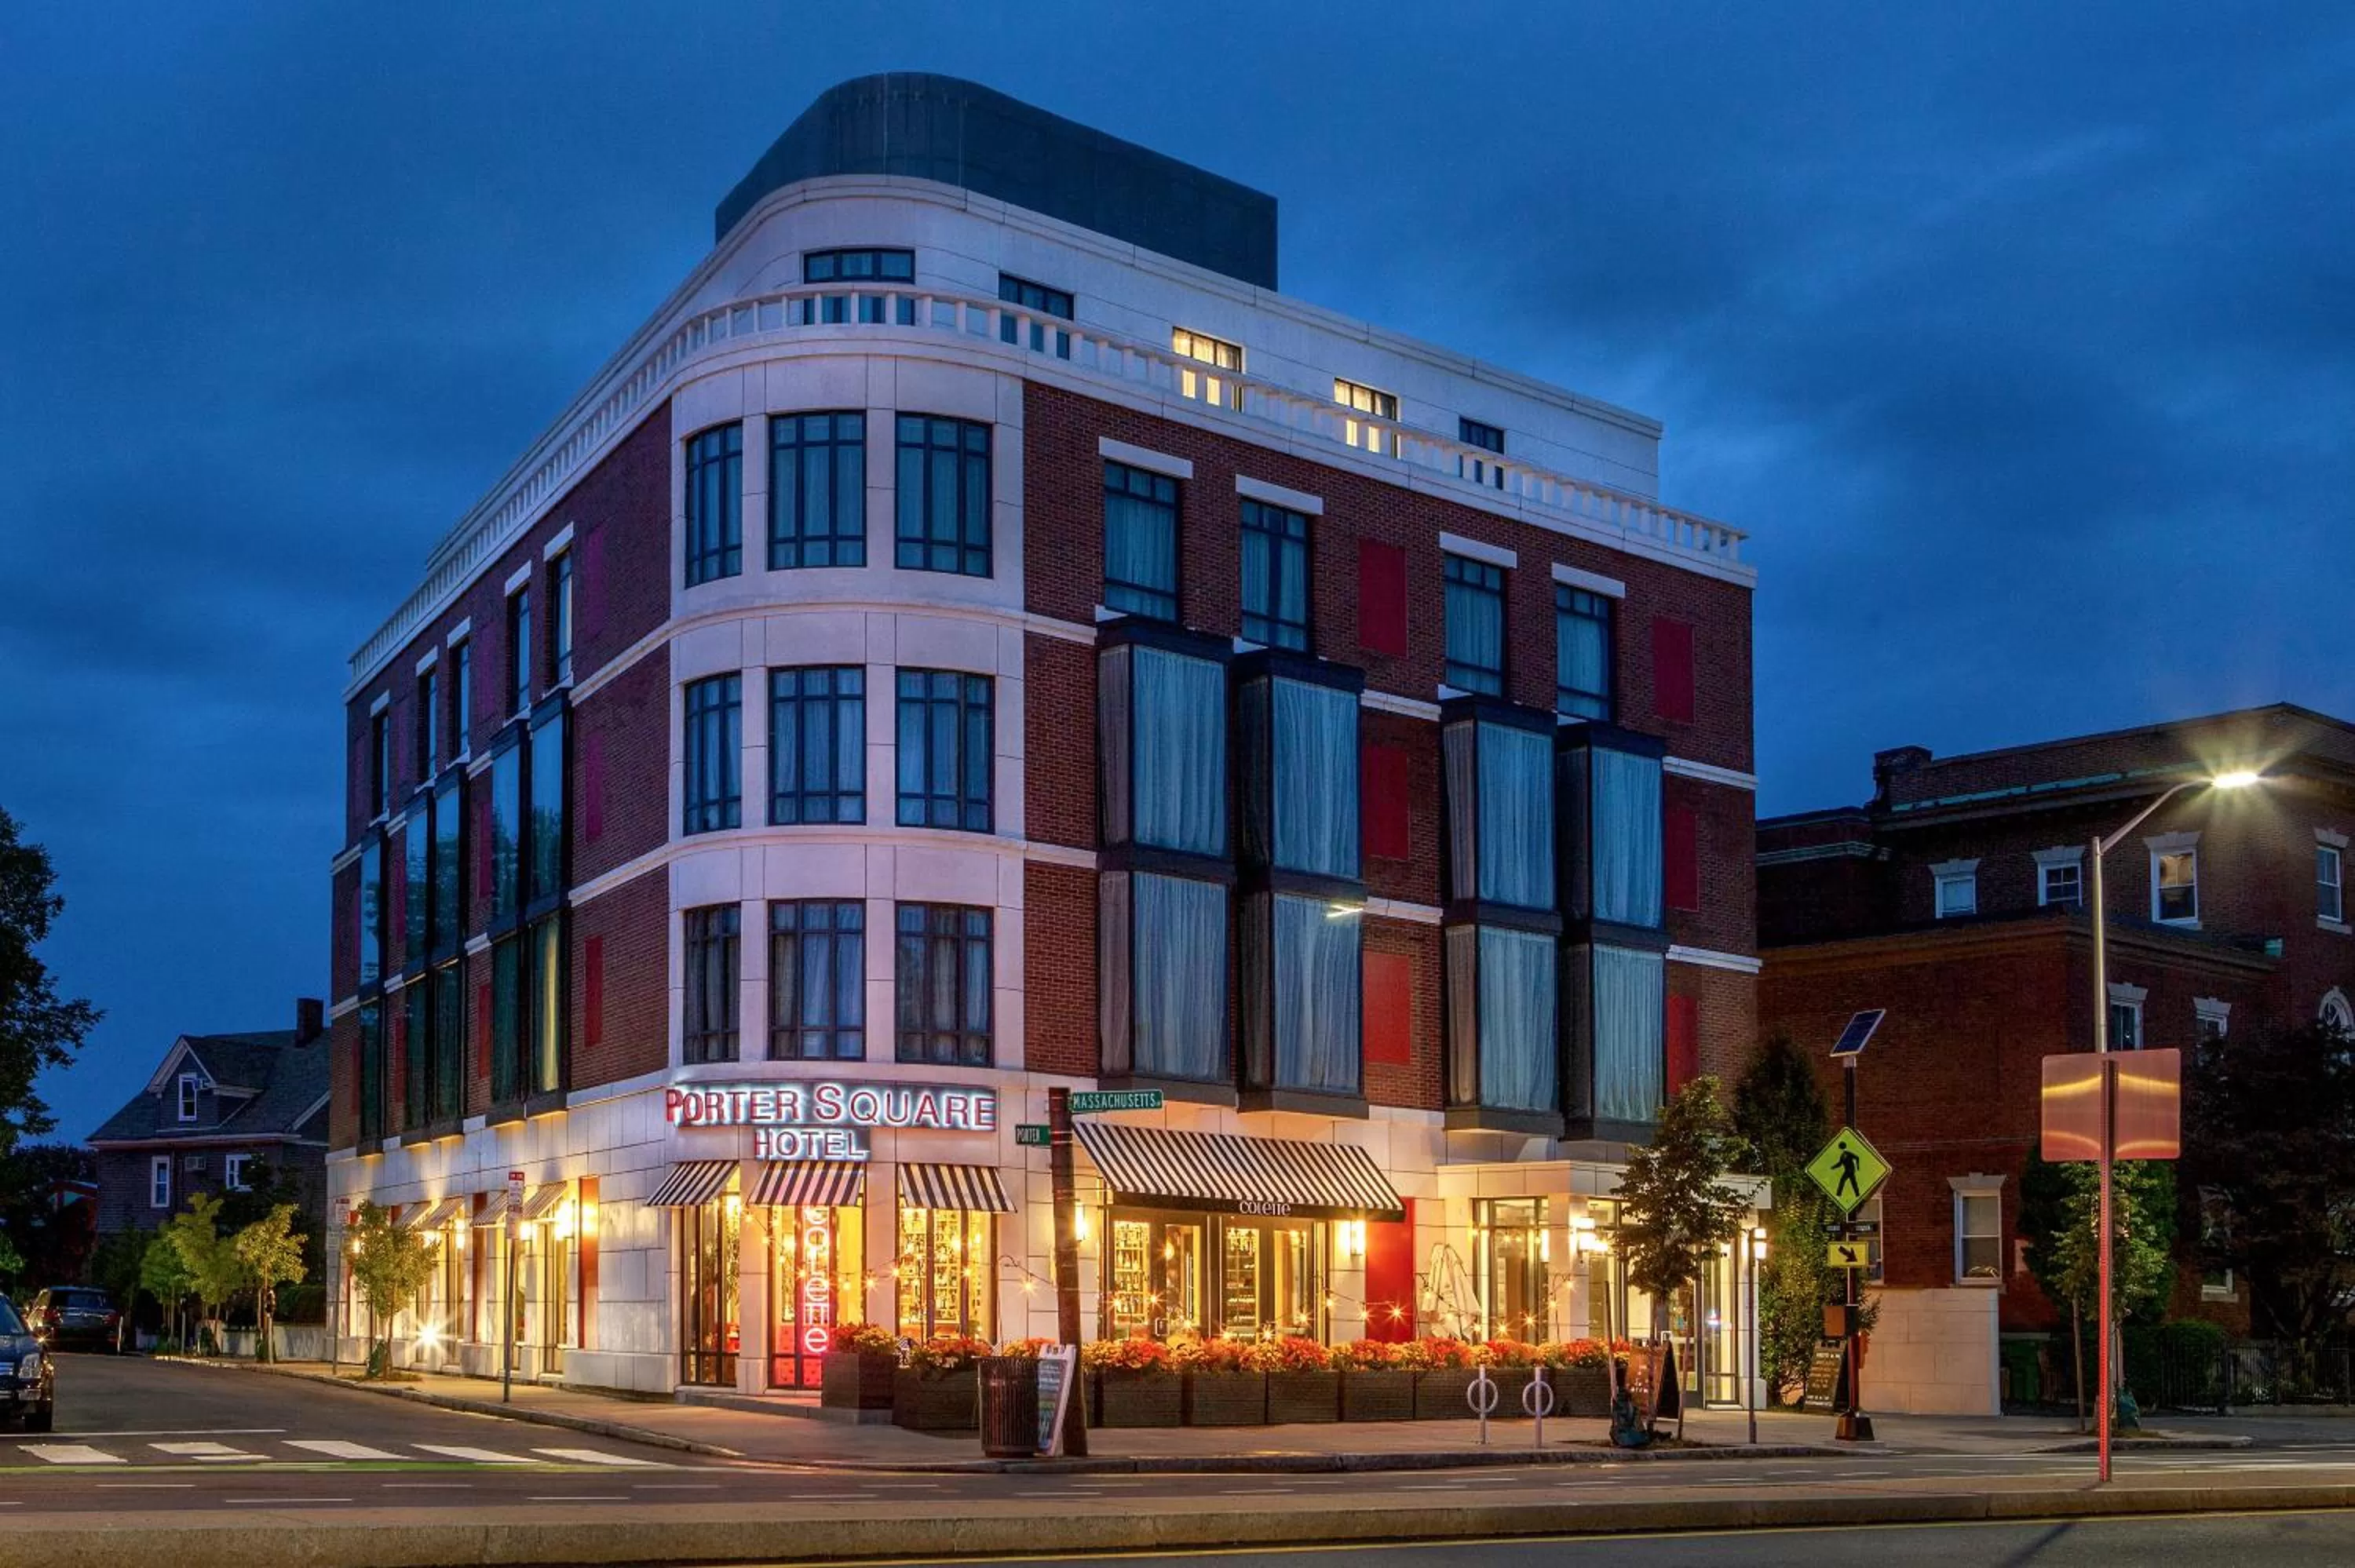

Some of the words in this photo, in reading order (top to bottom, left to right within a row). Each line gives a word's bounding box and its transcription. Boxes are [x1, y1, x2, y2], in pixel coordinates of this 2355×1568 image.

[666, 1088, 799, 1122] PORTER
[815, 1085, 996, 1126] SQUARE
[1073, 1093, 1156, 1110] MASSACHUSETTS
[754, 1131, 865, 1159] HOTEL
